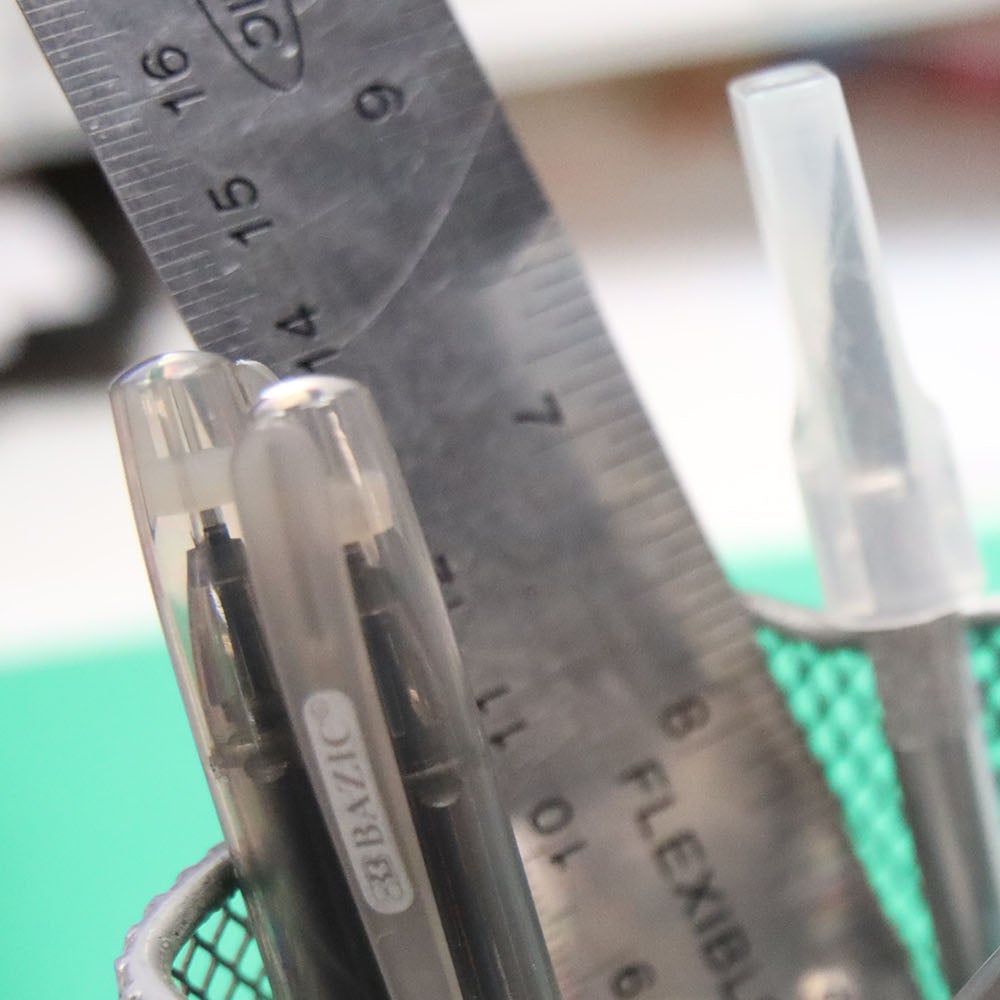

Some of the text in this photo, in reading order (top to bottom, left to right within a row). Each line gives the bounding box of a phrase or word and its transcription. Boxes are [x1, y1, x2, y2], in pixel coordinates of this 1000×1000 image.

[142, 46, 204, 115] 16
[208, 176, 273, 250] 15
[276, 303, 340, 372] 14
[513, 389, 562, 428] 7
[314, 707, 385, 848] BAZIC
[530, 798, 589, 872] 10
